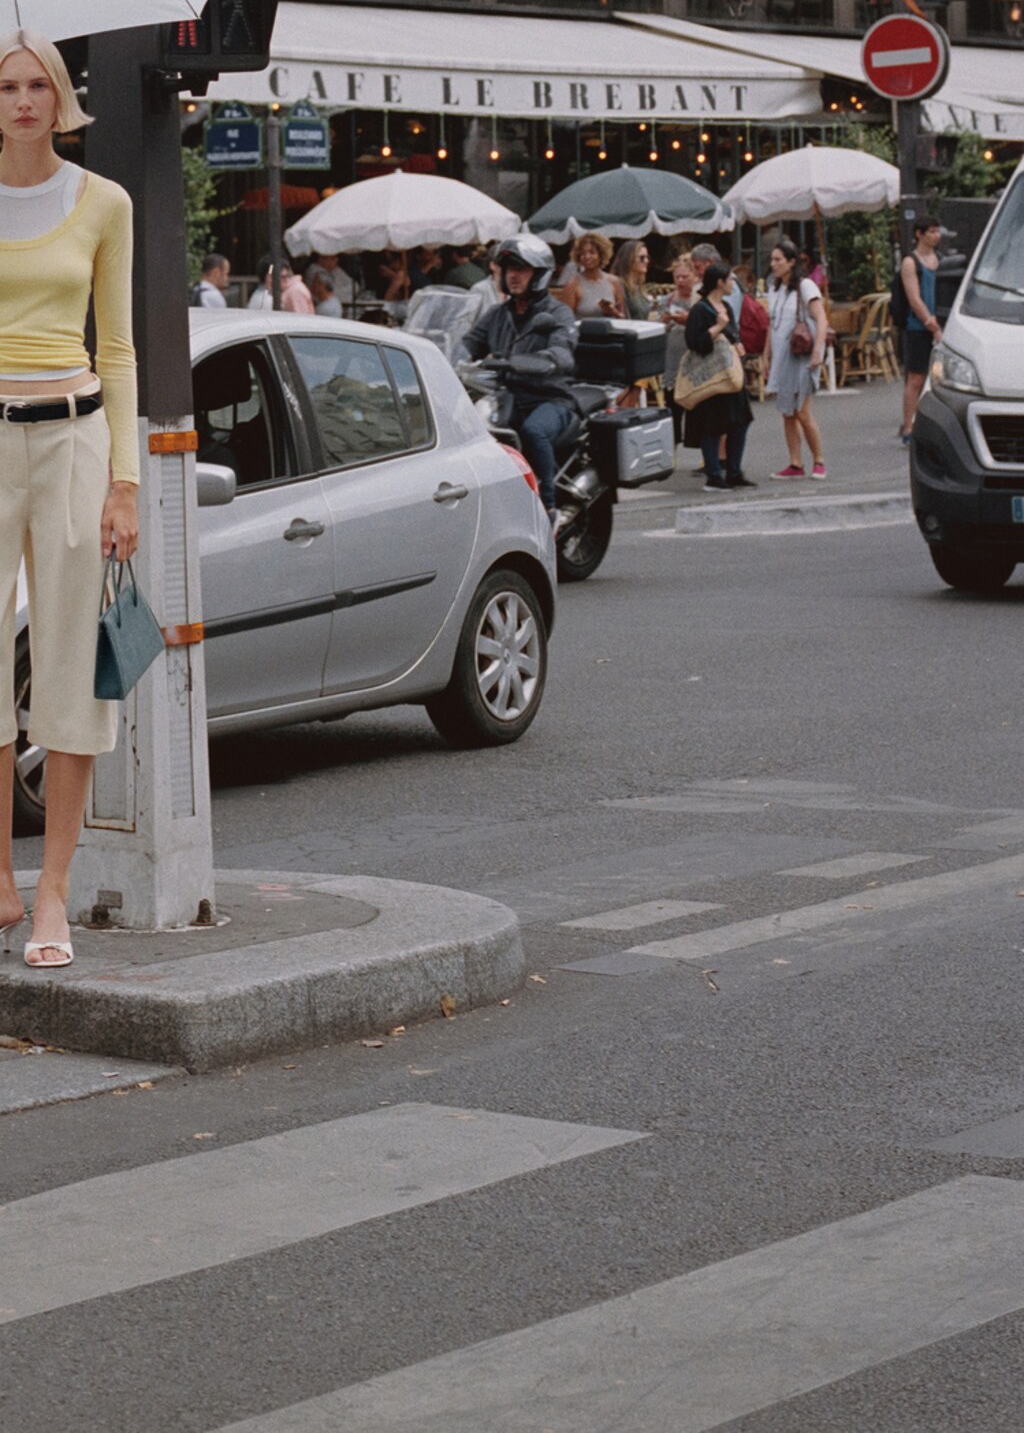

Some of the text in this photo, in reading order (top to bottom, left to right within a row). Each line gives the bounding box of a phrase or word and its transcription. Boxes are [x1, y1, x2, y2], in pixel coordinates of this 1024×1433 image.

[268, 67, 749, 112] CAFE LE BREBANT
